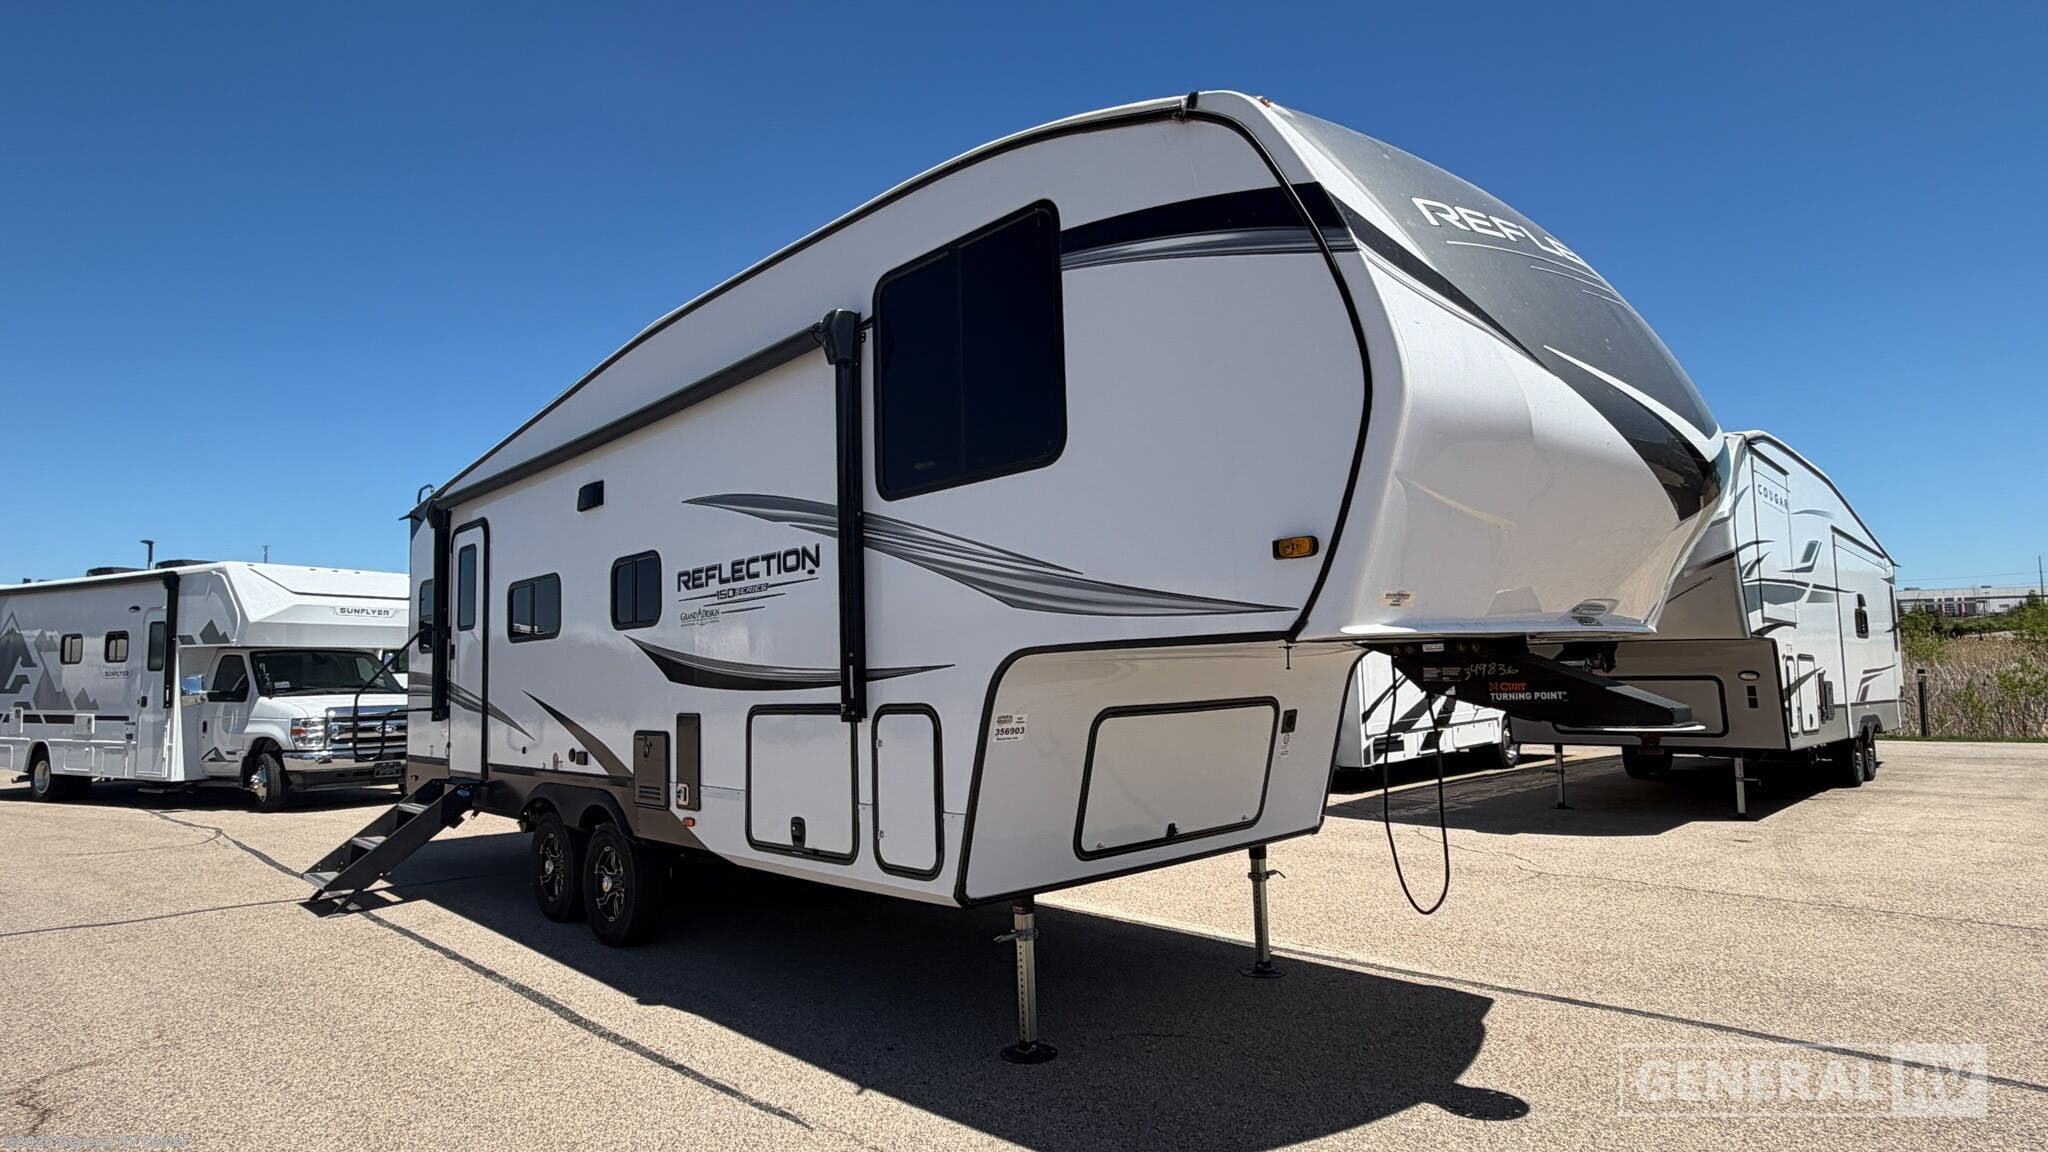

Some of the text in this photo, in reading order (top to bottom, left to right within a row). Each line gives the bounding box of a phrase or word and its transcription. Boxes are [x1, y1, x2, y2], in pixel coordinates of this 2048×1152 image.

[677, 543, 820, 592] REFLECTION
[339, 607, 390, 616] SUNFLYER
[1463, 662, 1520, 681] 349836
[1500, 682, 1527, 692] CURT
[1490, 692, 1532, 701] TURNING
[995, 727, 1025, 736] 356903
